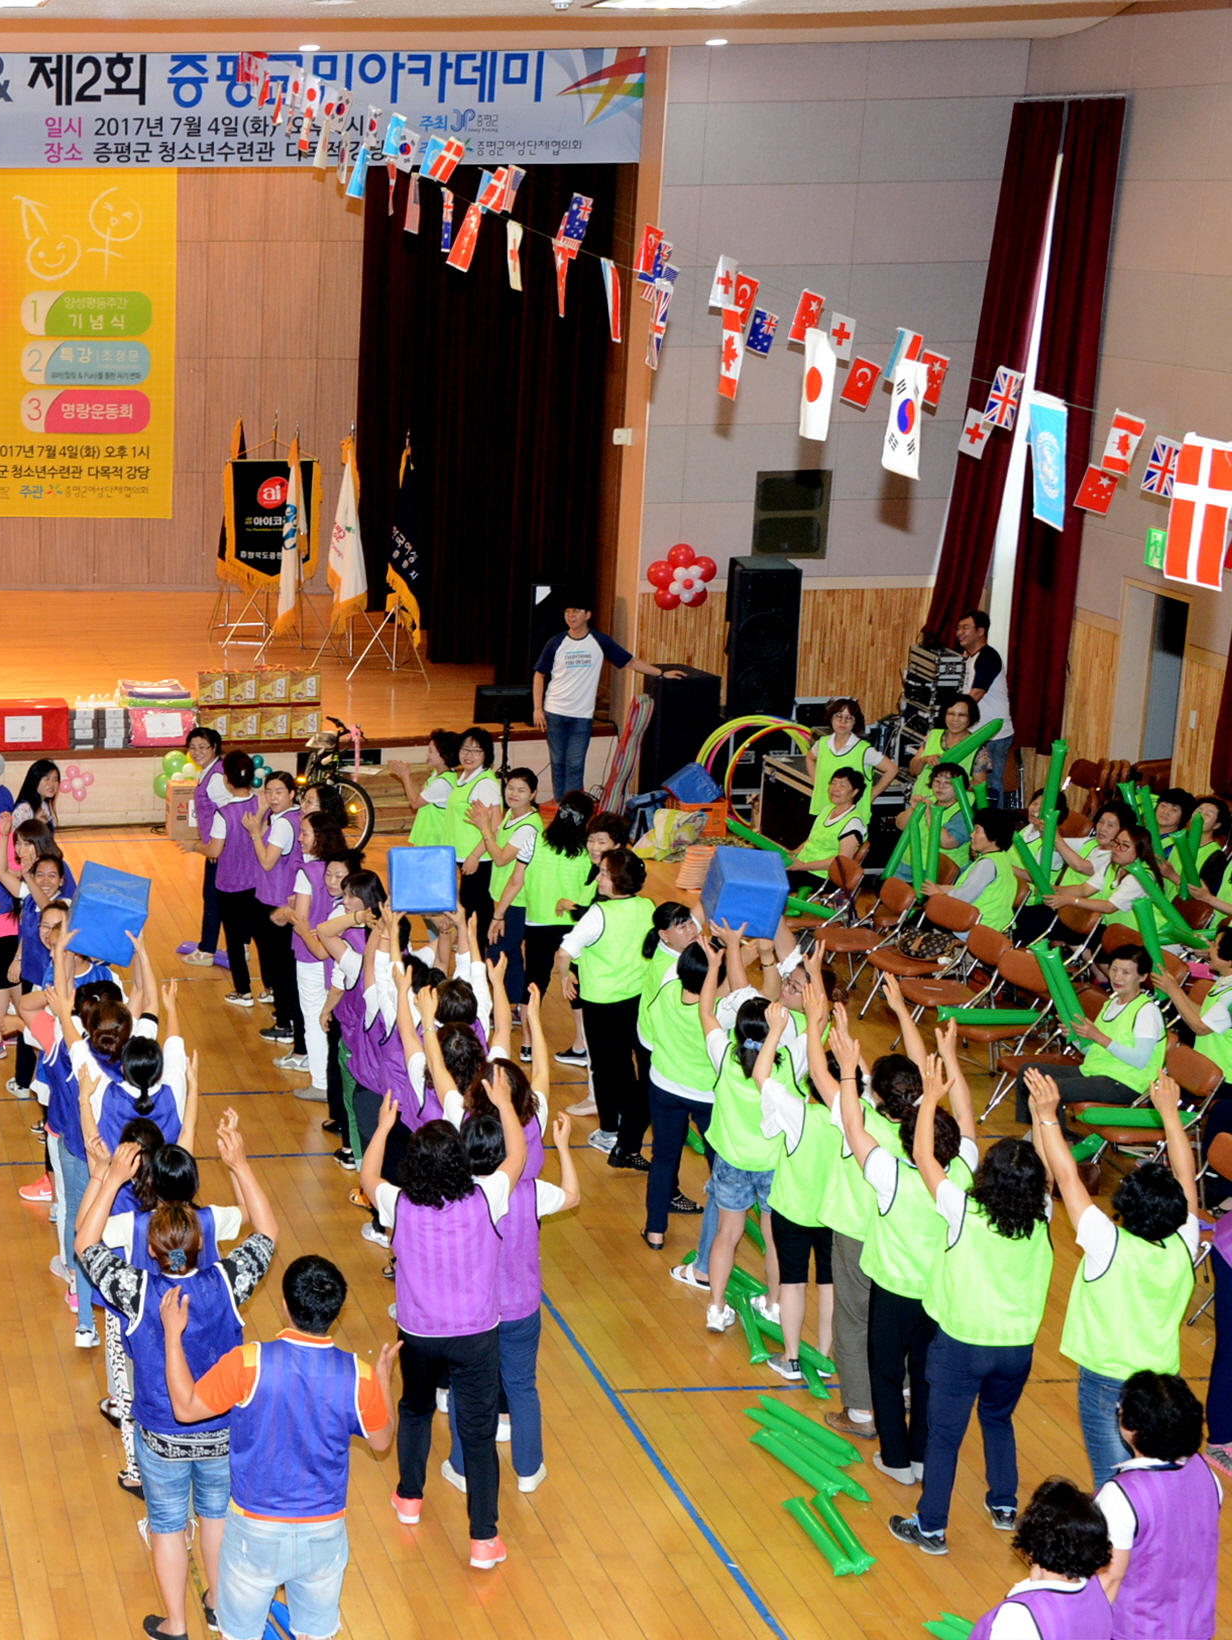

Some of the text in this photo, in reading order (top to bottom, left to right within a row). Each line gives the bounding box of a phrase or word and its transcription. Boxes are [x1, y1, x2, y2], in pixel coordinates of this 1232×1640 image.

[27, 53, 148, 108] 제2회
[44, 117, 83, 138] 일시
[93, 117, 164, 138] 2017년
[170, 117, 202, 138] 7월
[206, 116, 277, 139] 4일(화)
[419, 115, 448, 132] 주최
[476, 114, 499, 128] 증평군
[44, 142, 84, 164] 장소
[93, 142, 153, 163] 증평군
[158, 142, 275, 163] 청소년수련관
[476, 139, 583, 156] 증평군여성단체협의회
[31, 300, 38, 323] 1
[63, 296, 128, 310] 양성평등주간
[27, 348, 43, 372] 2
[59, 347, 93, 364] 특강
[27, 398, 42, 421] 3
[61, 403, 134, 420] 명랑운동회
[37, 445, 57, 459] 7월
[58, 445, 101, 459] 4일(화)
[103, 446, 128, 459] 오후
[132, 446, 151, 459] 1시
[11, 465, 83, 480] 청소년수련관
[87, 465, 123, 480] 다목적
[126, 465, 151, 480] 강당
[19, 485, 44, 499] 주관
[262, 484, 282, 501] ai
[253, 516, 286, 526] 아이코
